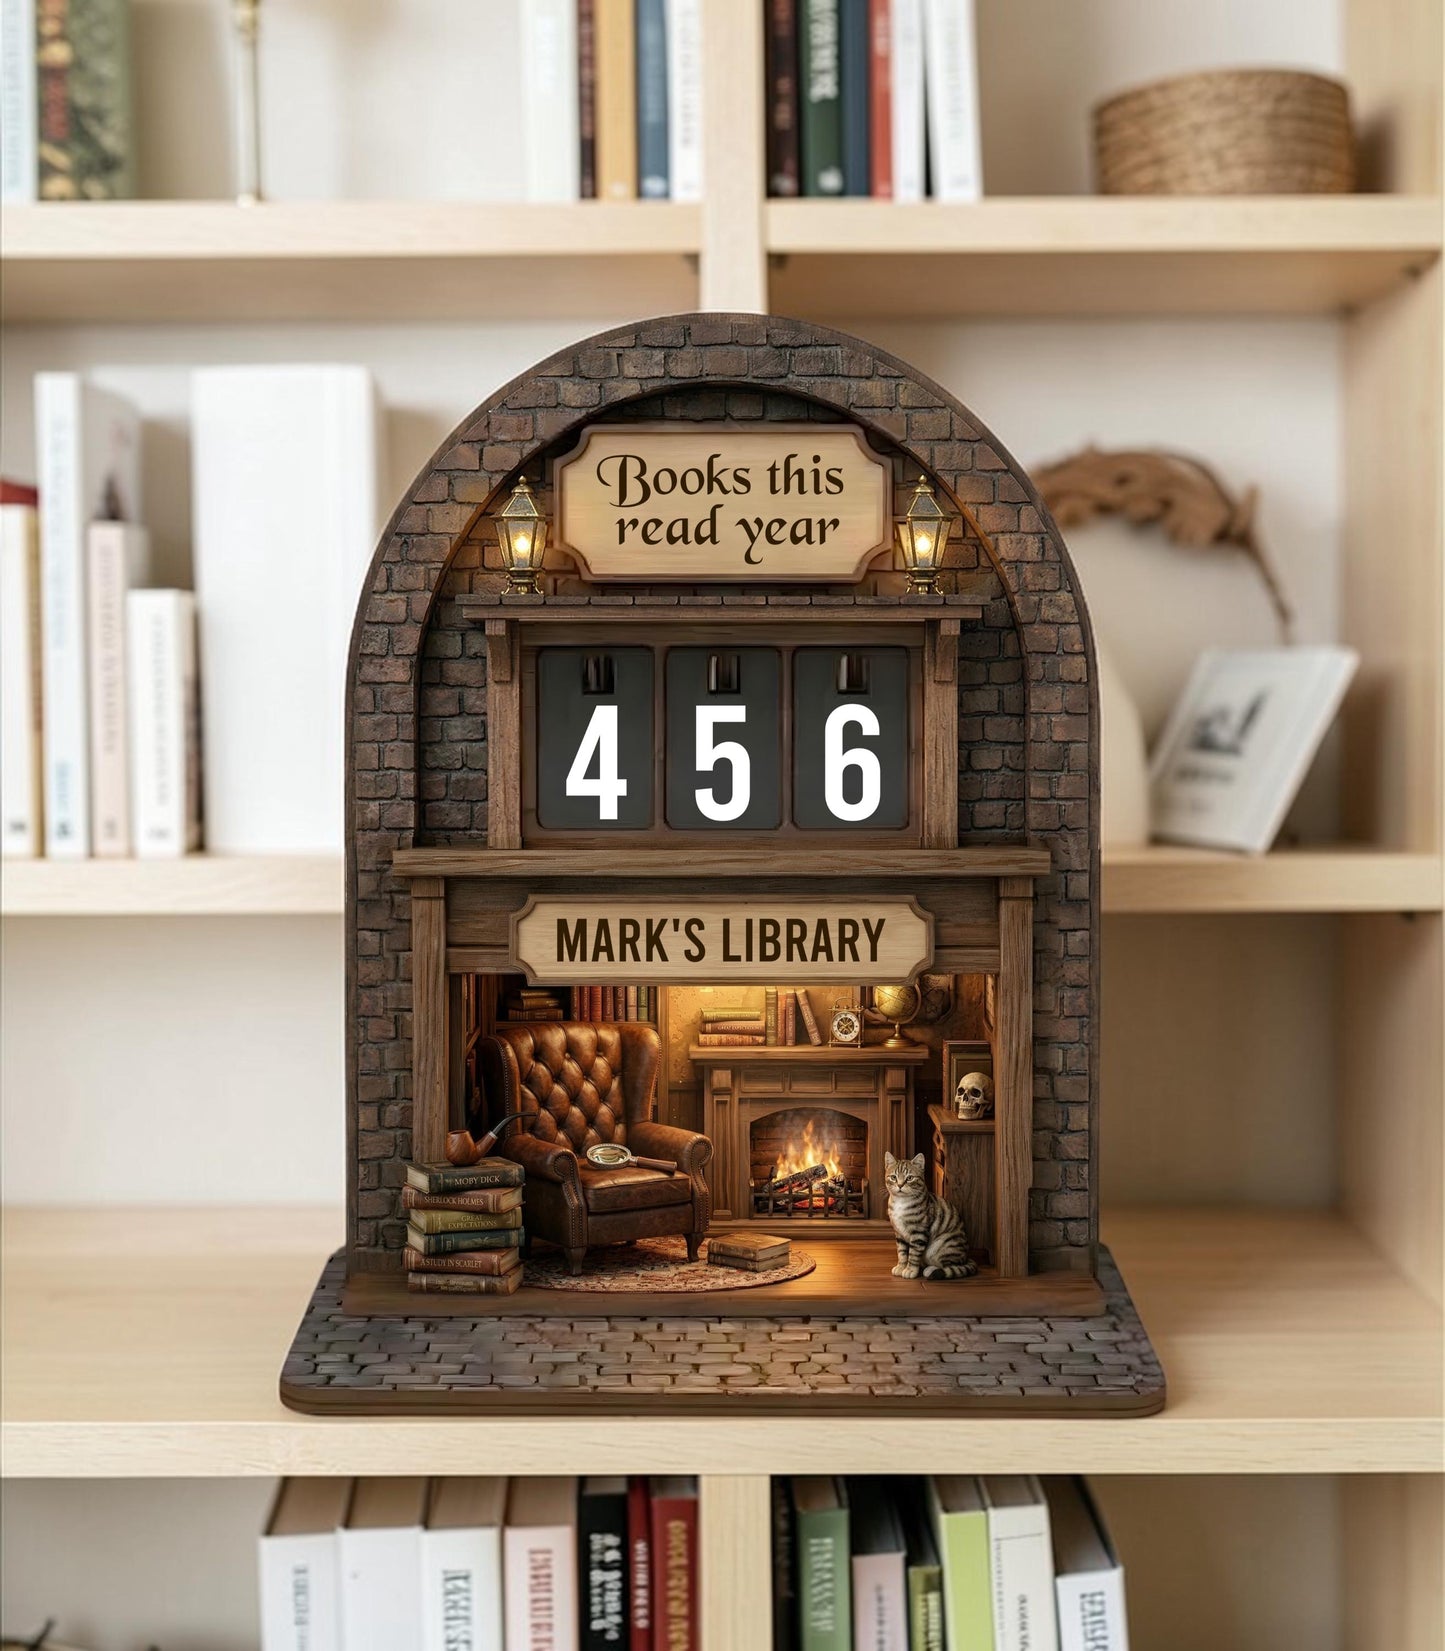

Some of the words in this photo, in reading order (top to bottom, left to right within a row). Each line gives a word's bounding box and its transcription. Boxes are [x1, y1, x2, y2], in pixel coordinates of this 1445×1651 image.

[597, 454, 751, 507] Books
[767, 454, 844, 496] this
[616, 504, 724, 546] read
[735, 516, 840, 565] year
[556, 918, 706, 963] MARK'S
[722, 918, 887, 963] LIBRARY
[454, 1177, 479, 1186] MOBY
[480, 1175, 501, 1184] DICK
[424, 1196, 457, 1205] SHERLOCK
[457, 1197, 484, 1206] HOLMES
[448, 1220, 497, 1229] EXPECTATIONS
[426, 1259, 446, 1267] STUDY
[447, 1259, 455, 1267] IN
[455, 1259, 482, 1268] SCARLET
